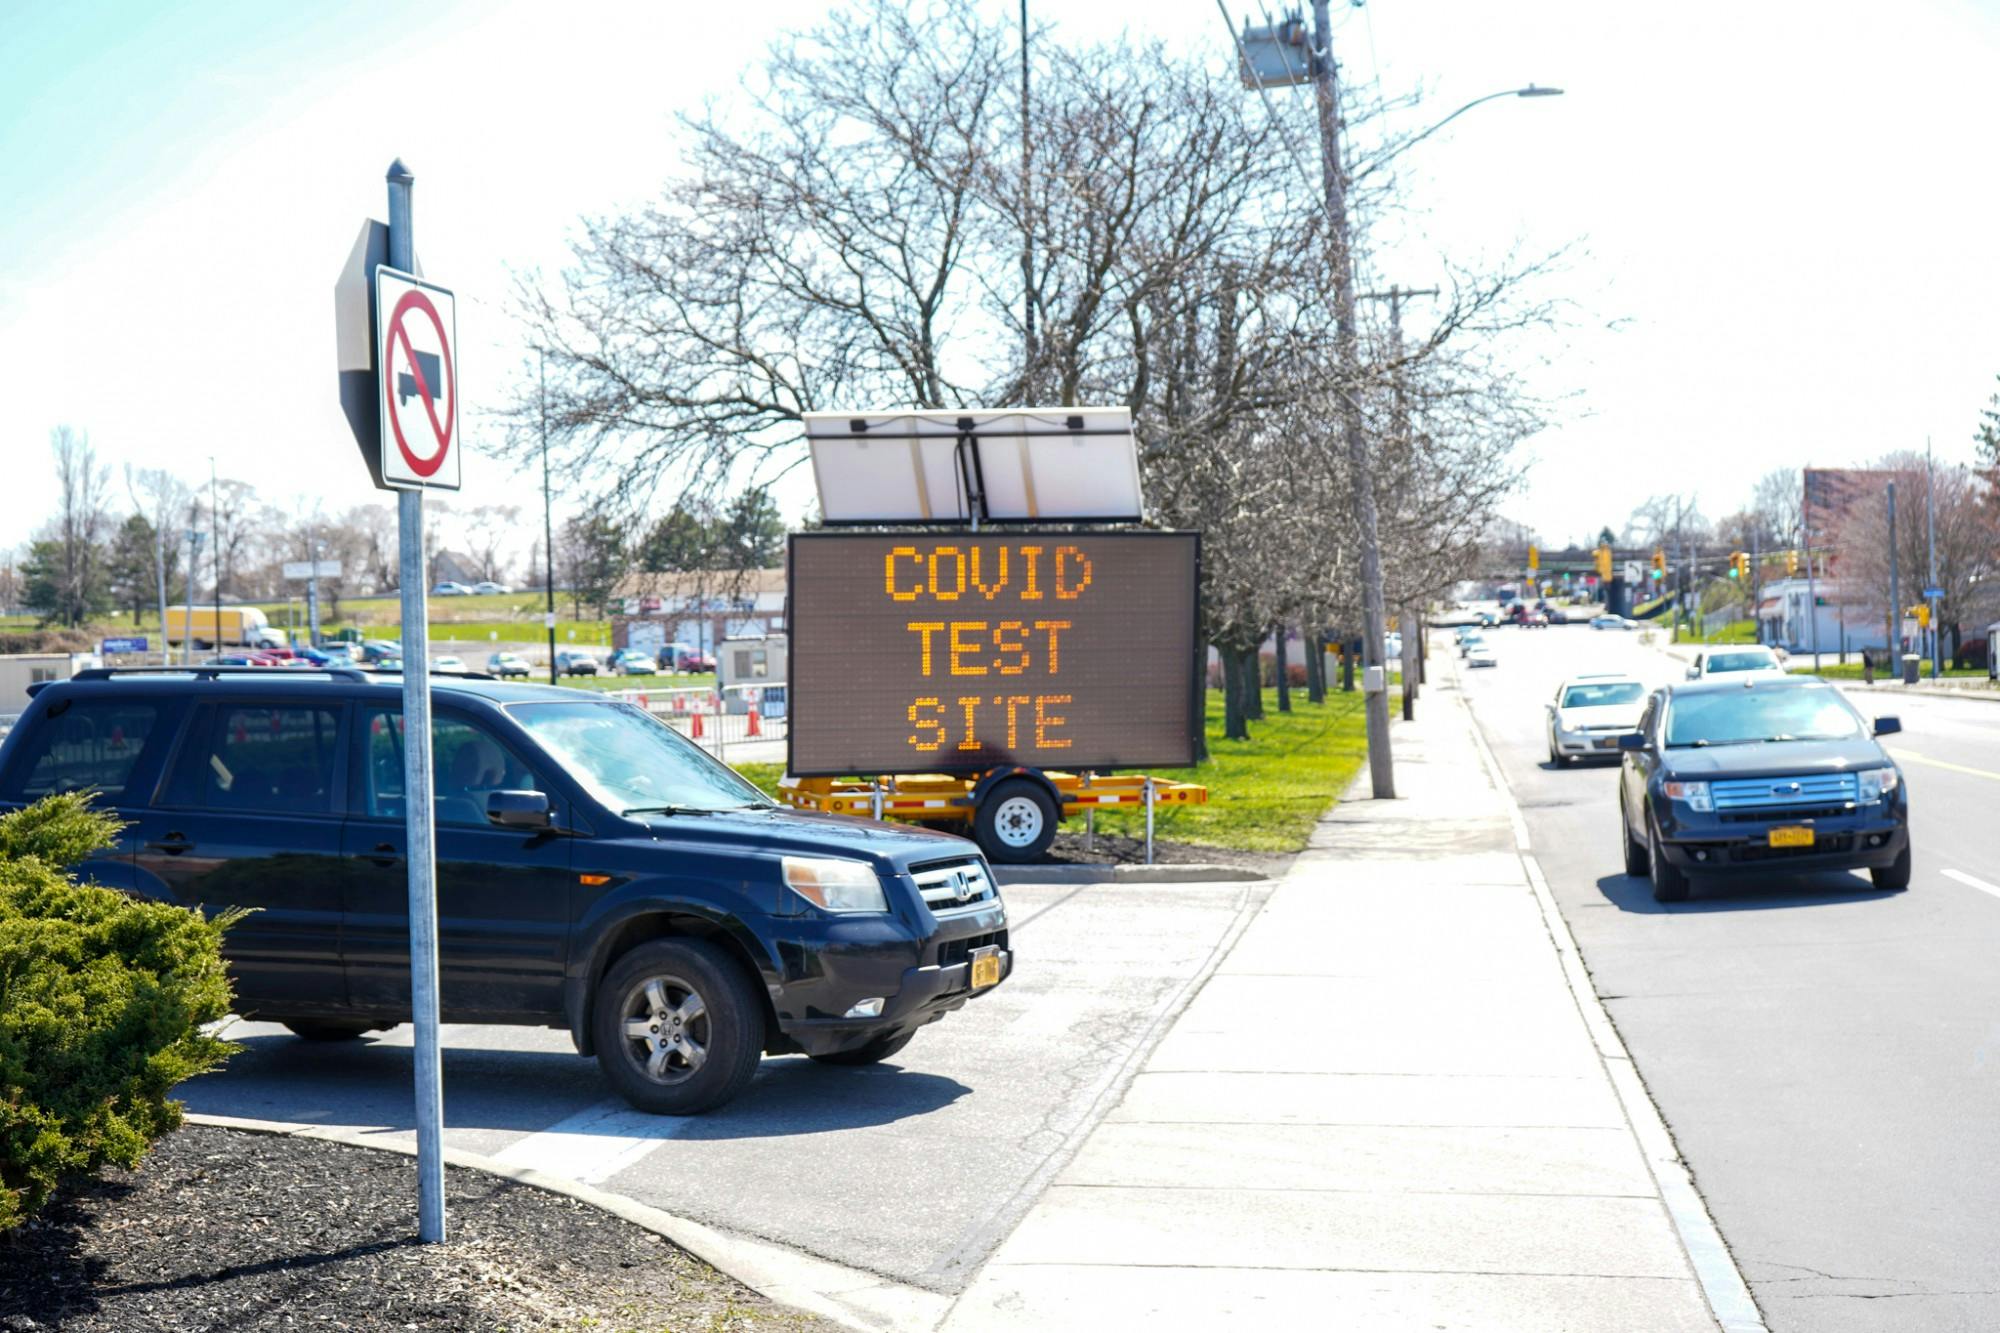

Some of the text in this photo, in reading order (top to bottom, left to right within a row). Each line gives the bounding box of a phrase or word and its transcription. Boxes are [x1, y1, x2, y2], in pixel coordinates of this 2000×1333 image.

[885, 546, 1092, 601] COVID
[907, 620, 1072, 676] TEST
[908, 695, 1072, 751] SITE
